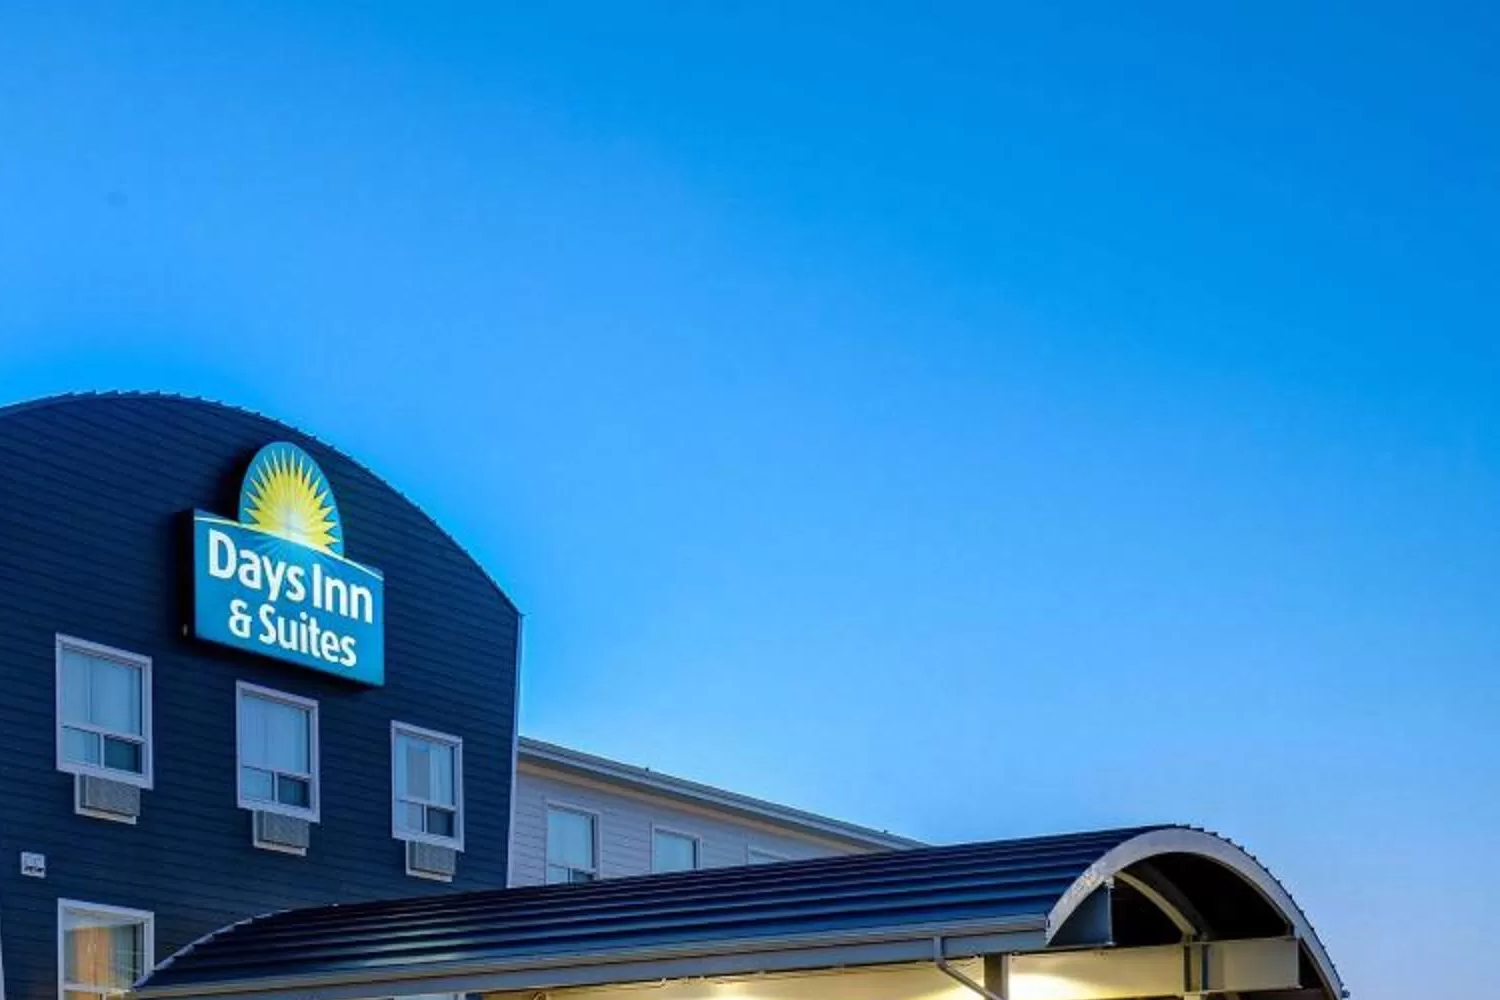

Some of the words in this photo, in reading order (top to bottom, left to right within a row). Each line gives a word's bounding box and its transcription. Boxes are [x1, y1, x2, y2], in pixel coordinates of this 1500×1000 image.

[208, 528, 306, 602] Days
[312, 563, 373, 624] Inn
[228, 599, 252, 639] &
[258, 603, 357, 667] Suites
